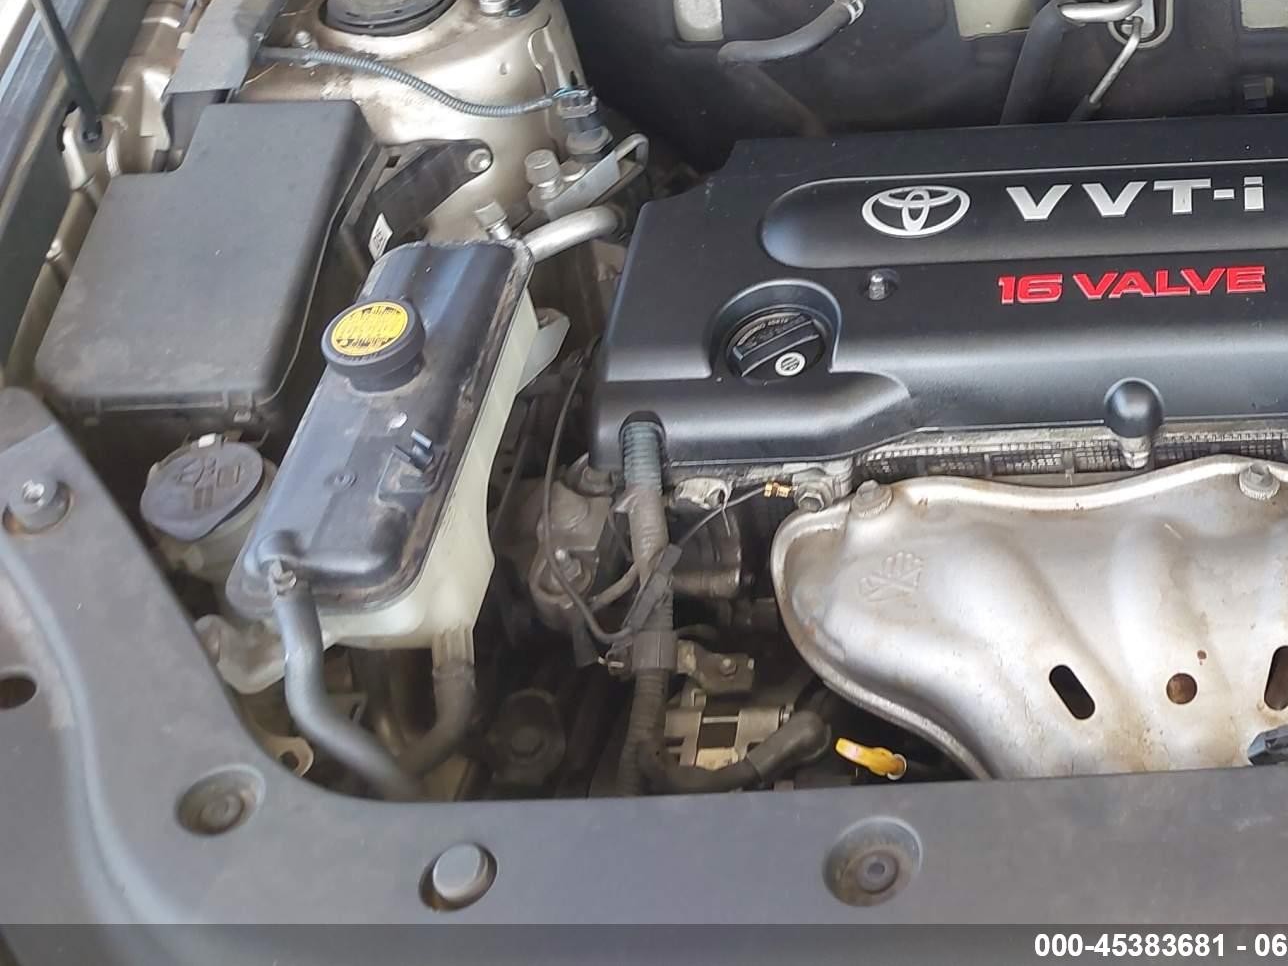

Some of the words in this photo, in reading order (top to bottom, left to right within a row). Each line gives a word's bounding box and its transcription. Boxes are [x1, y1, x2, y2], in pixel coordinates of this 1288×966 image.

[1005, 176, 1265, 221] VVT-i
[998, 273, 1064, 305] 16
[1072, 265, 1267, 300] VALVE
